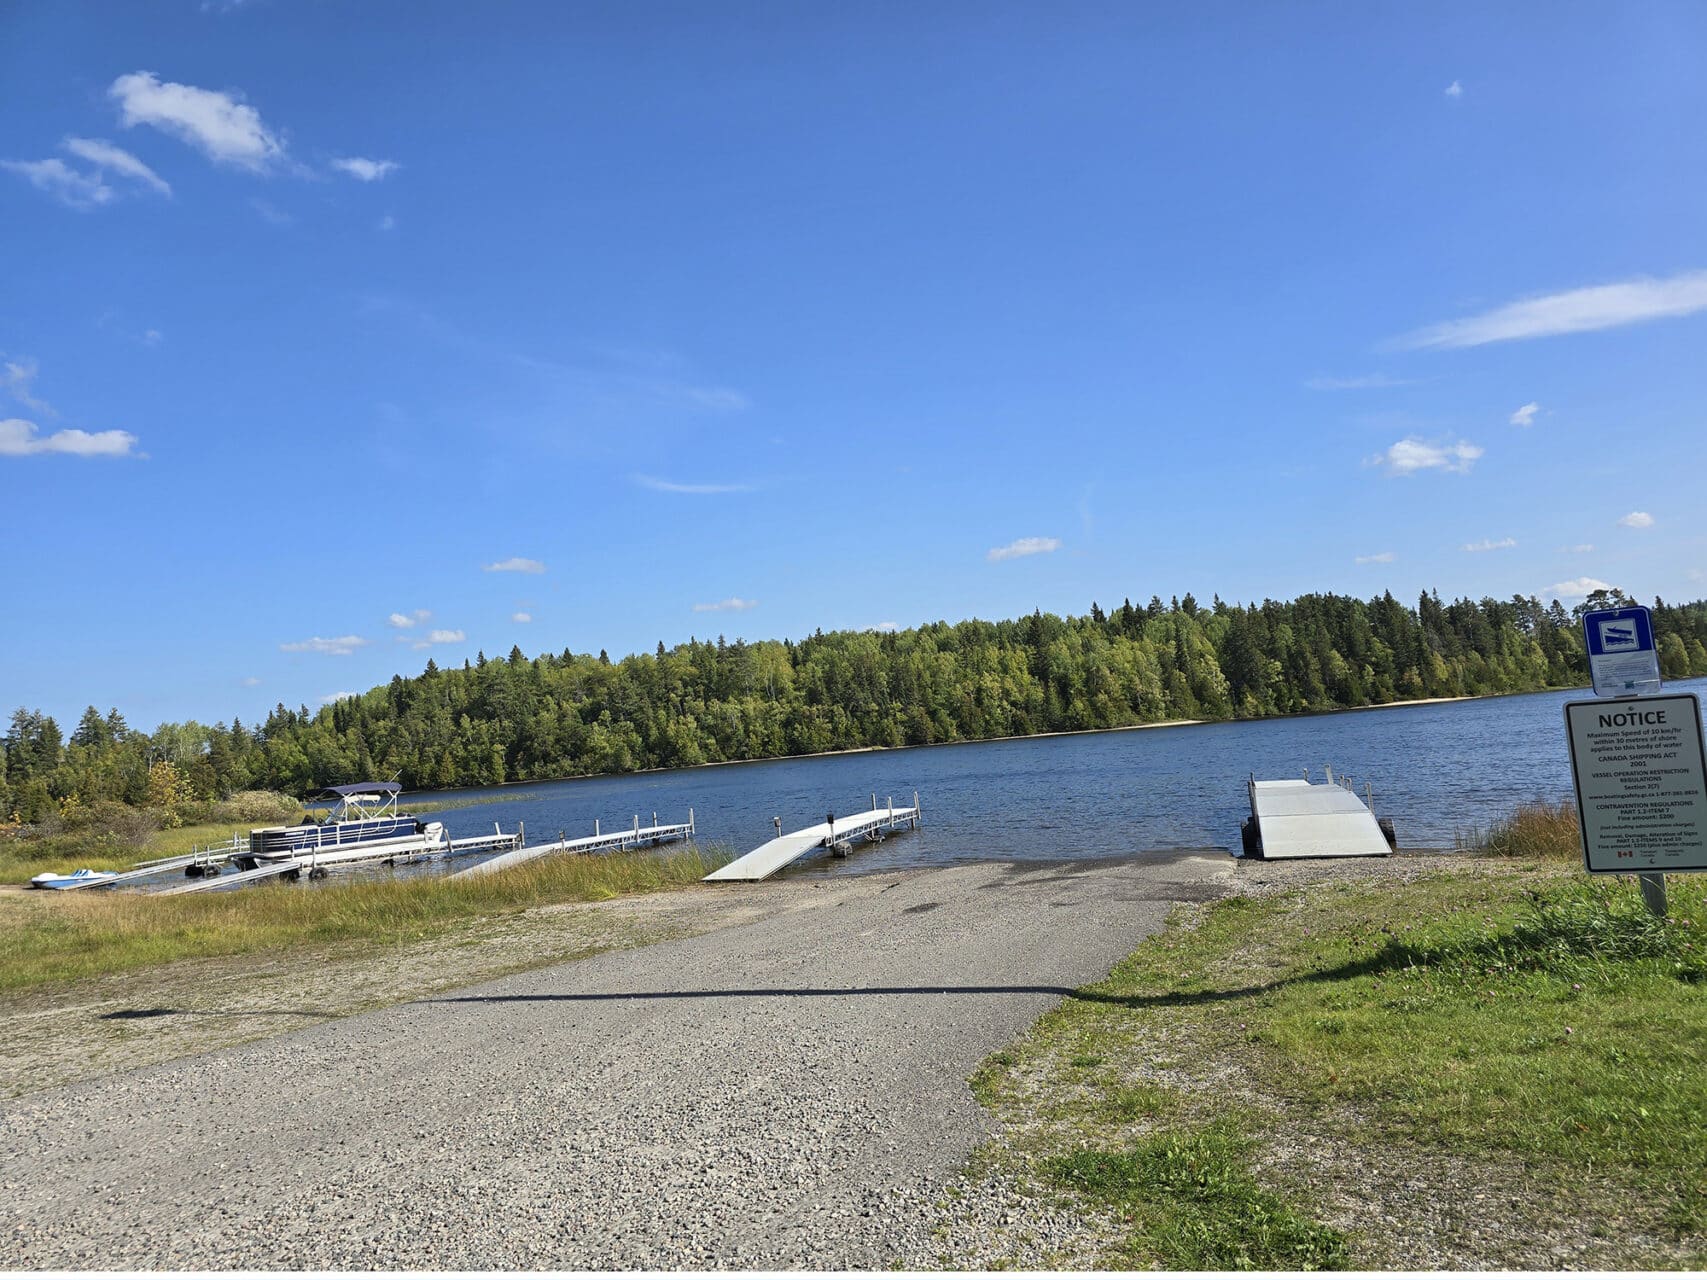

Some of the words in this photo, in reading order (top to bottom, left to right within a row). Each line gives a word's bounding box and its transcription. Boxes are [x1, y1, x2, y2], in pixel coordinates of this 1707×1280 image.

[1598, 710, 1666, 728] NOTICE
[1636, 742, 1653, 750] body
[1629, 753, 1661, 761] SHIPPING
